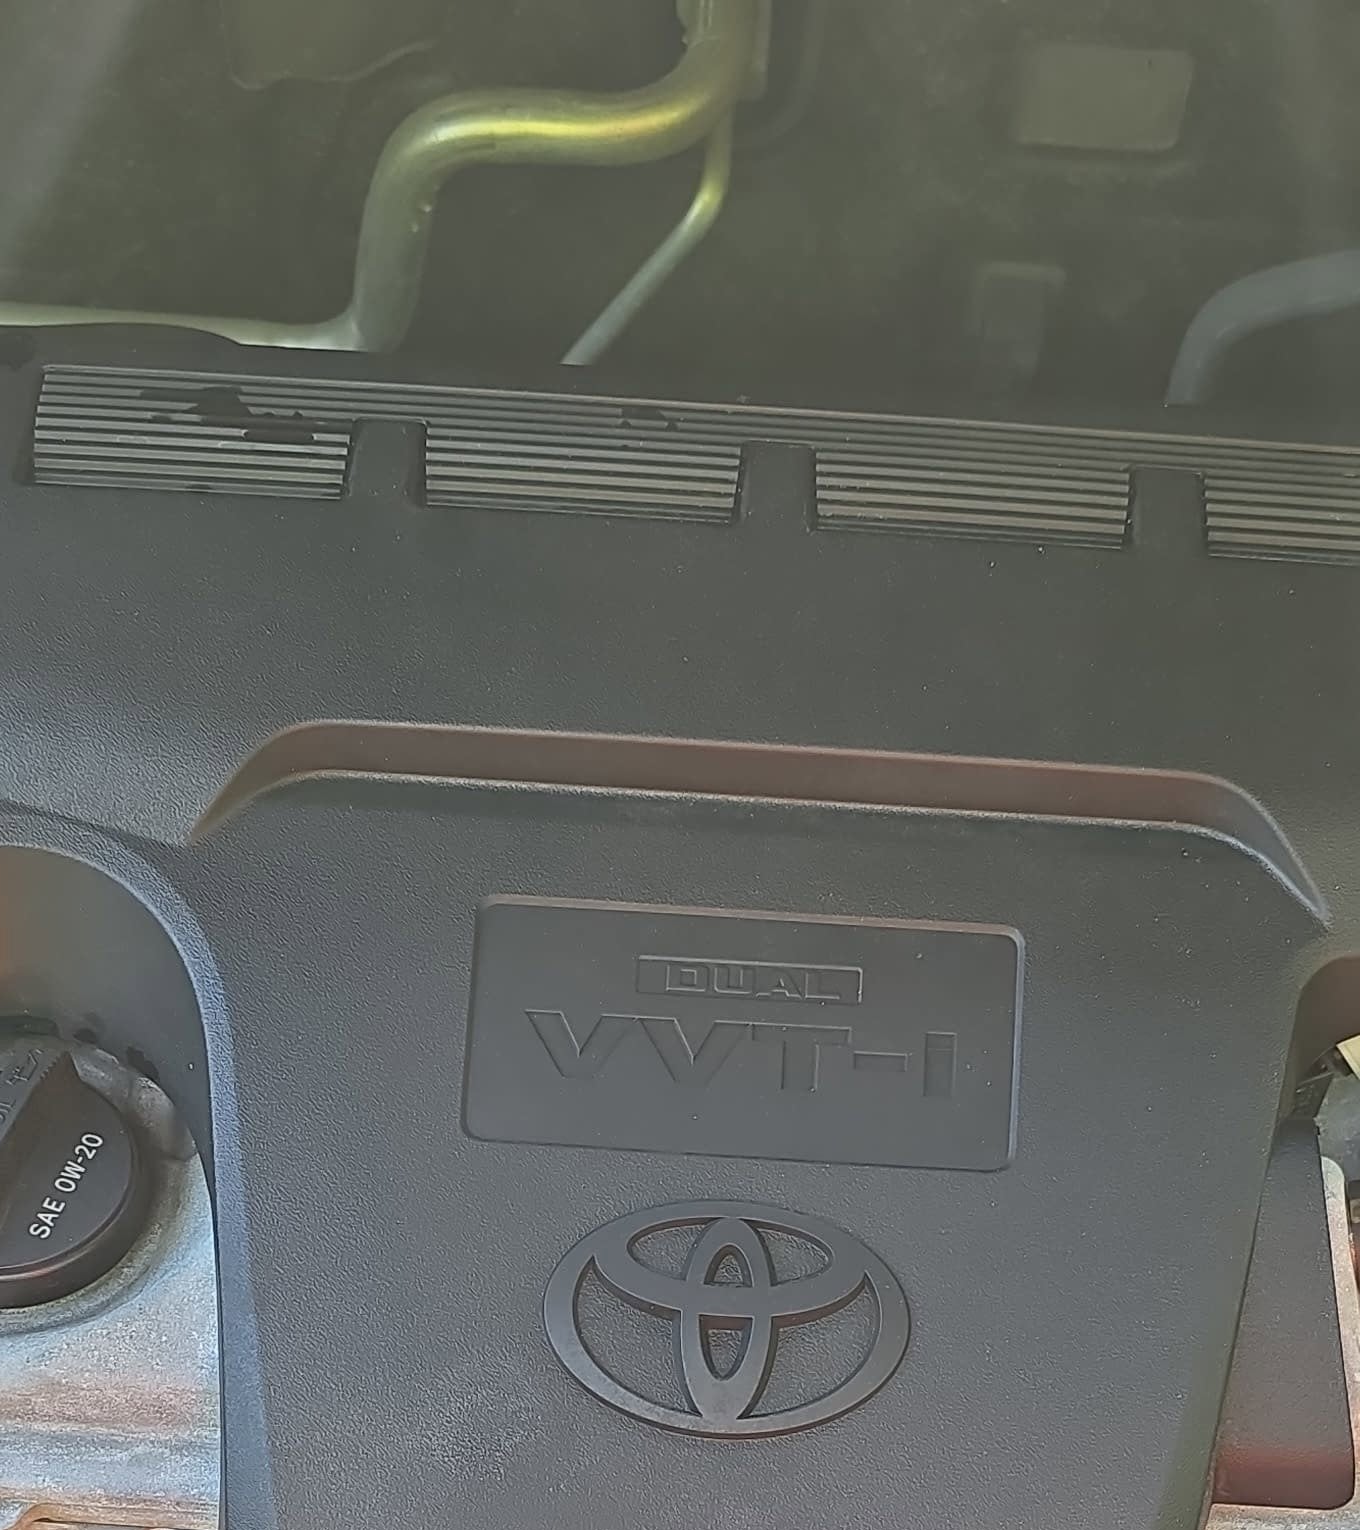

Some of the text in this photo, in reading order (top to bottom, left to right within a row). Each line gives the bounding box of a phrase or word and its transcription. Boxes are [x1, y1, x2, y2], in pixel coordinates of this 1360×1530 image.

[664, 962, 843, 1001] DUAL
[29, 1132, 105, 1240] SAE 0W-20
